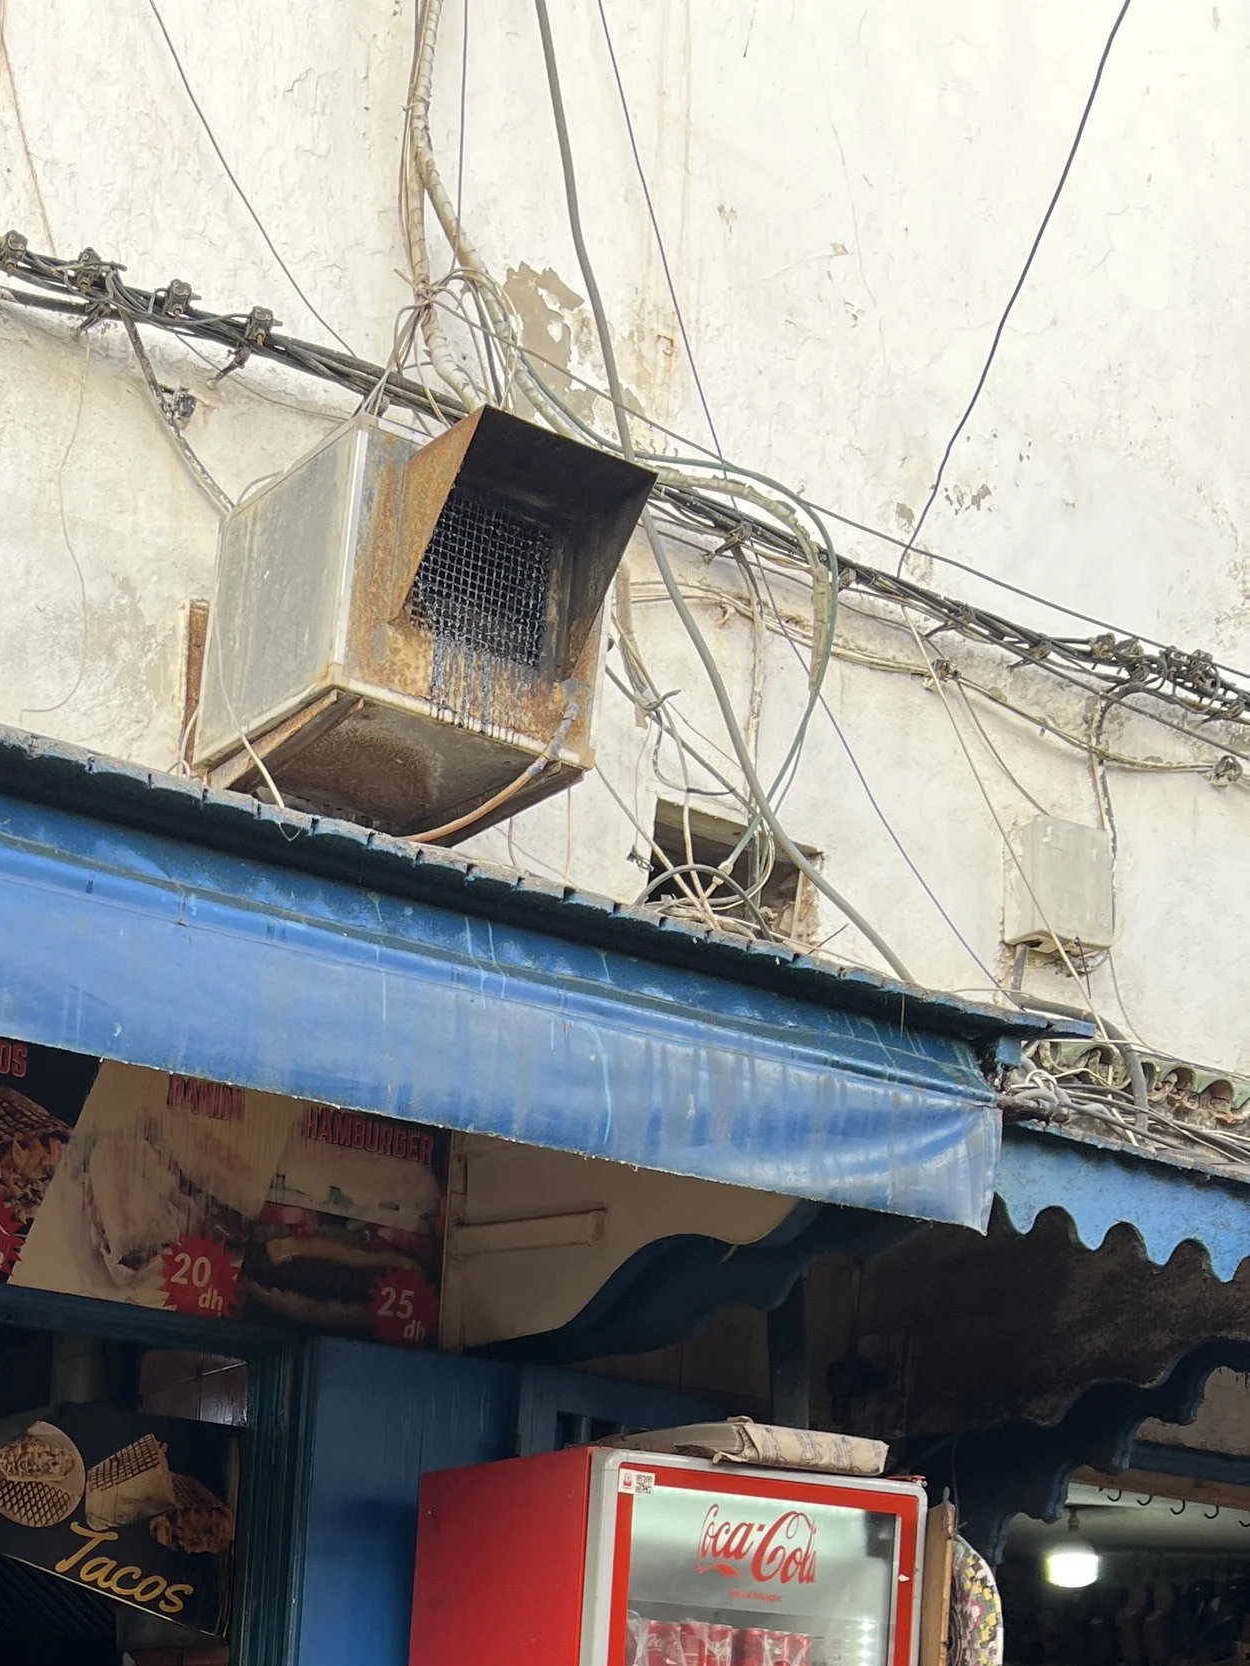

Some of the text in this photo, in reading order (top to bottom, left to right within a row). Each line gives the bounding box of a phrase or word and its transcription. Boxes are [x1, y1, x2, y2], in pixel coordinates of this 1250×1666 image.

[302, 1105, 434, 1164] HAMBURGER
[170, 1252, 212, 1288] 20
[198, 1287, 223, 1311] dh
[377, 1286, 415, 1319] 25
[403, 1319, 427, 1341] dh
[55, 1520, 194, 1614] Tacos
